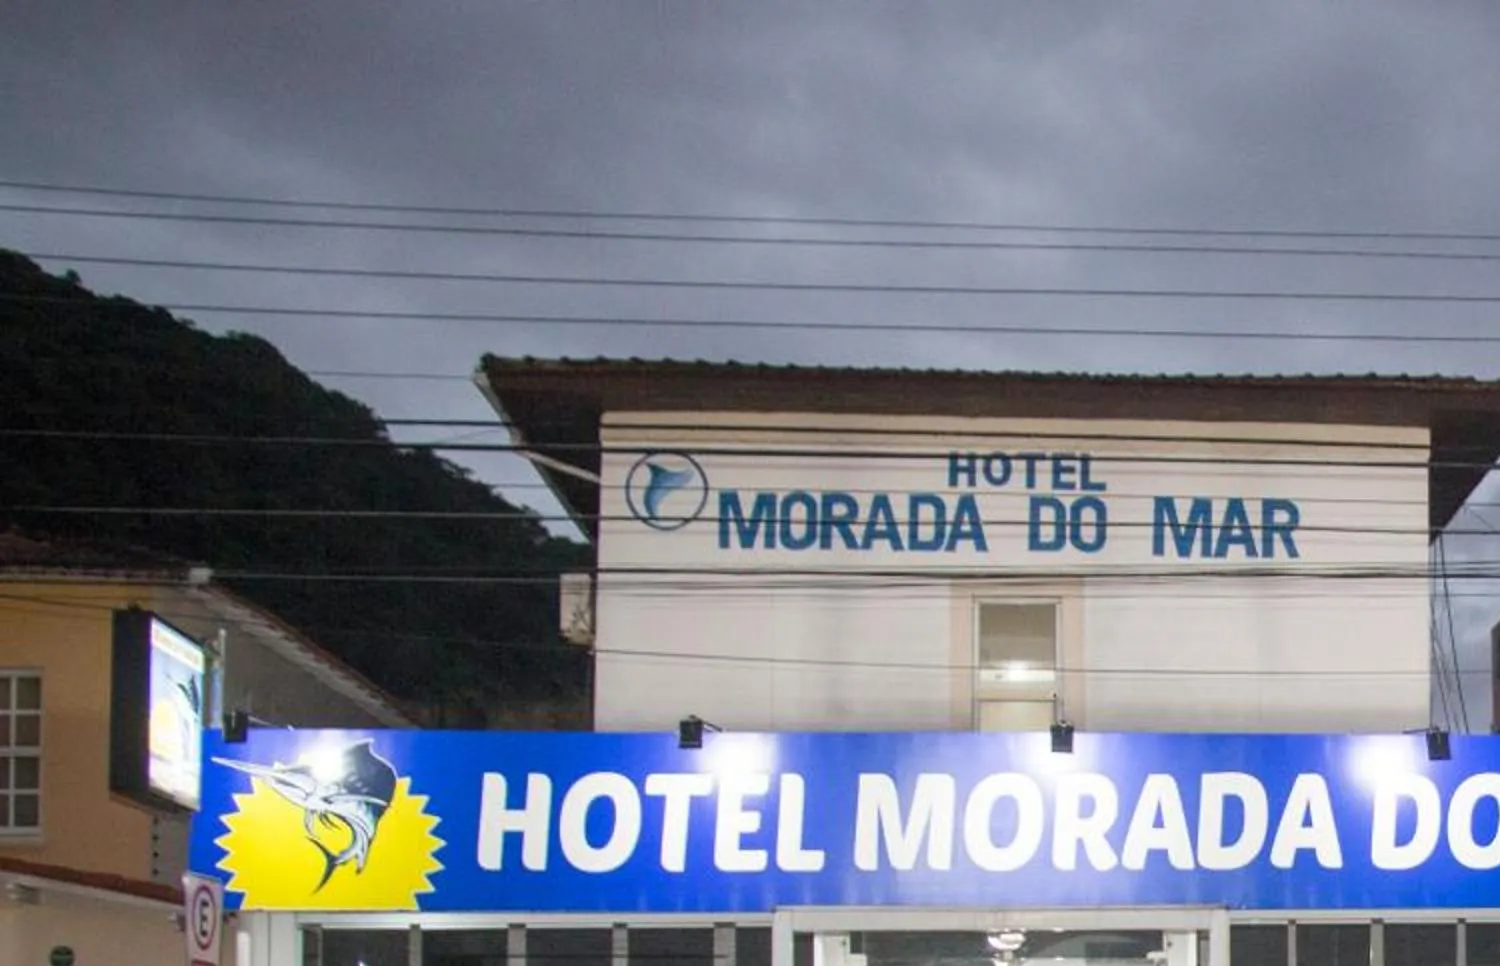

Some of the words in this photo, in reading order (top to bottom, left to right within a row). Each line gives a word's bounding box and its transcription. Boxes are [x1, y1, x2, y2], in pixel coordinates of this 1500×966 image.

[947, 451, 1106, 491] HOTEL
[718, 490, 989, 553] MORADA
[1028, 495, 1107, 553] DO
[1152, 496, 1301, 559] MAR
[477, 771, 825, 873] HOTEL
[854, 772, 1344, 872] MORADA
